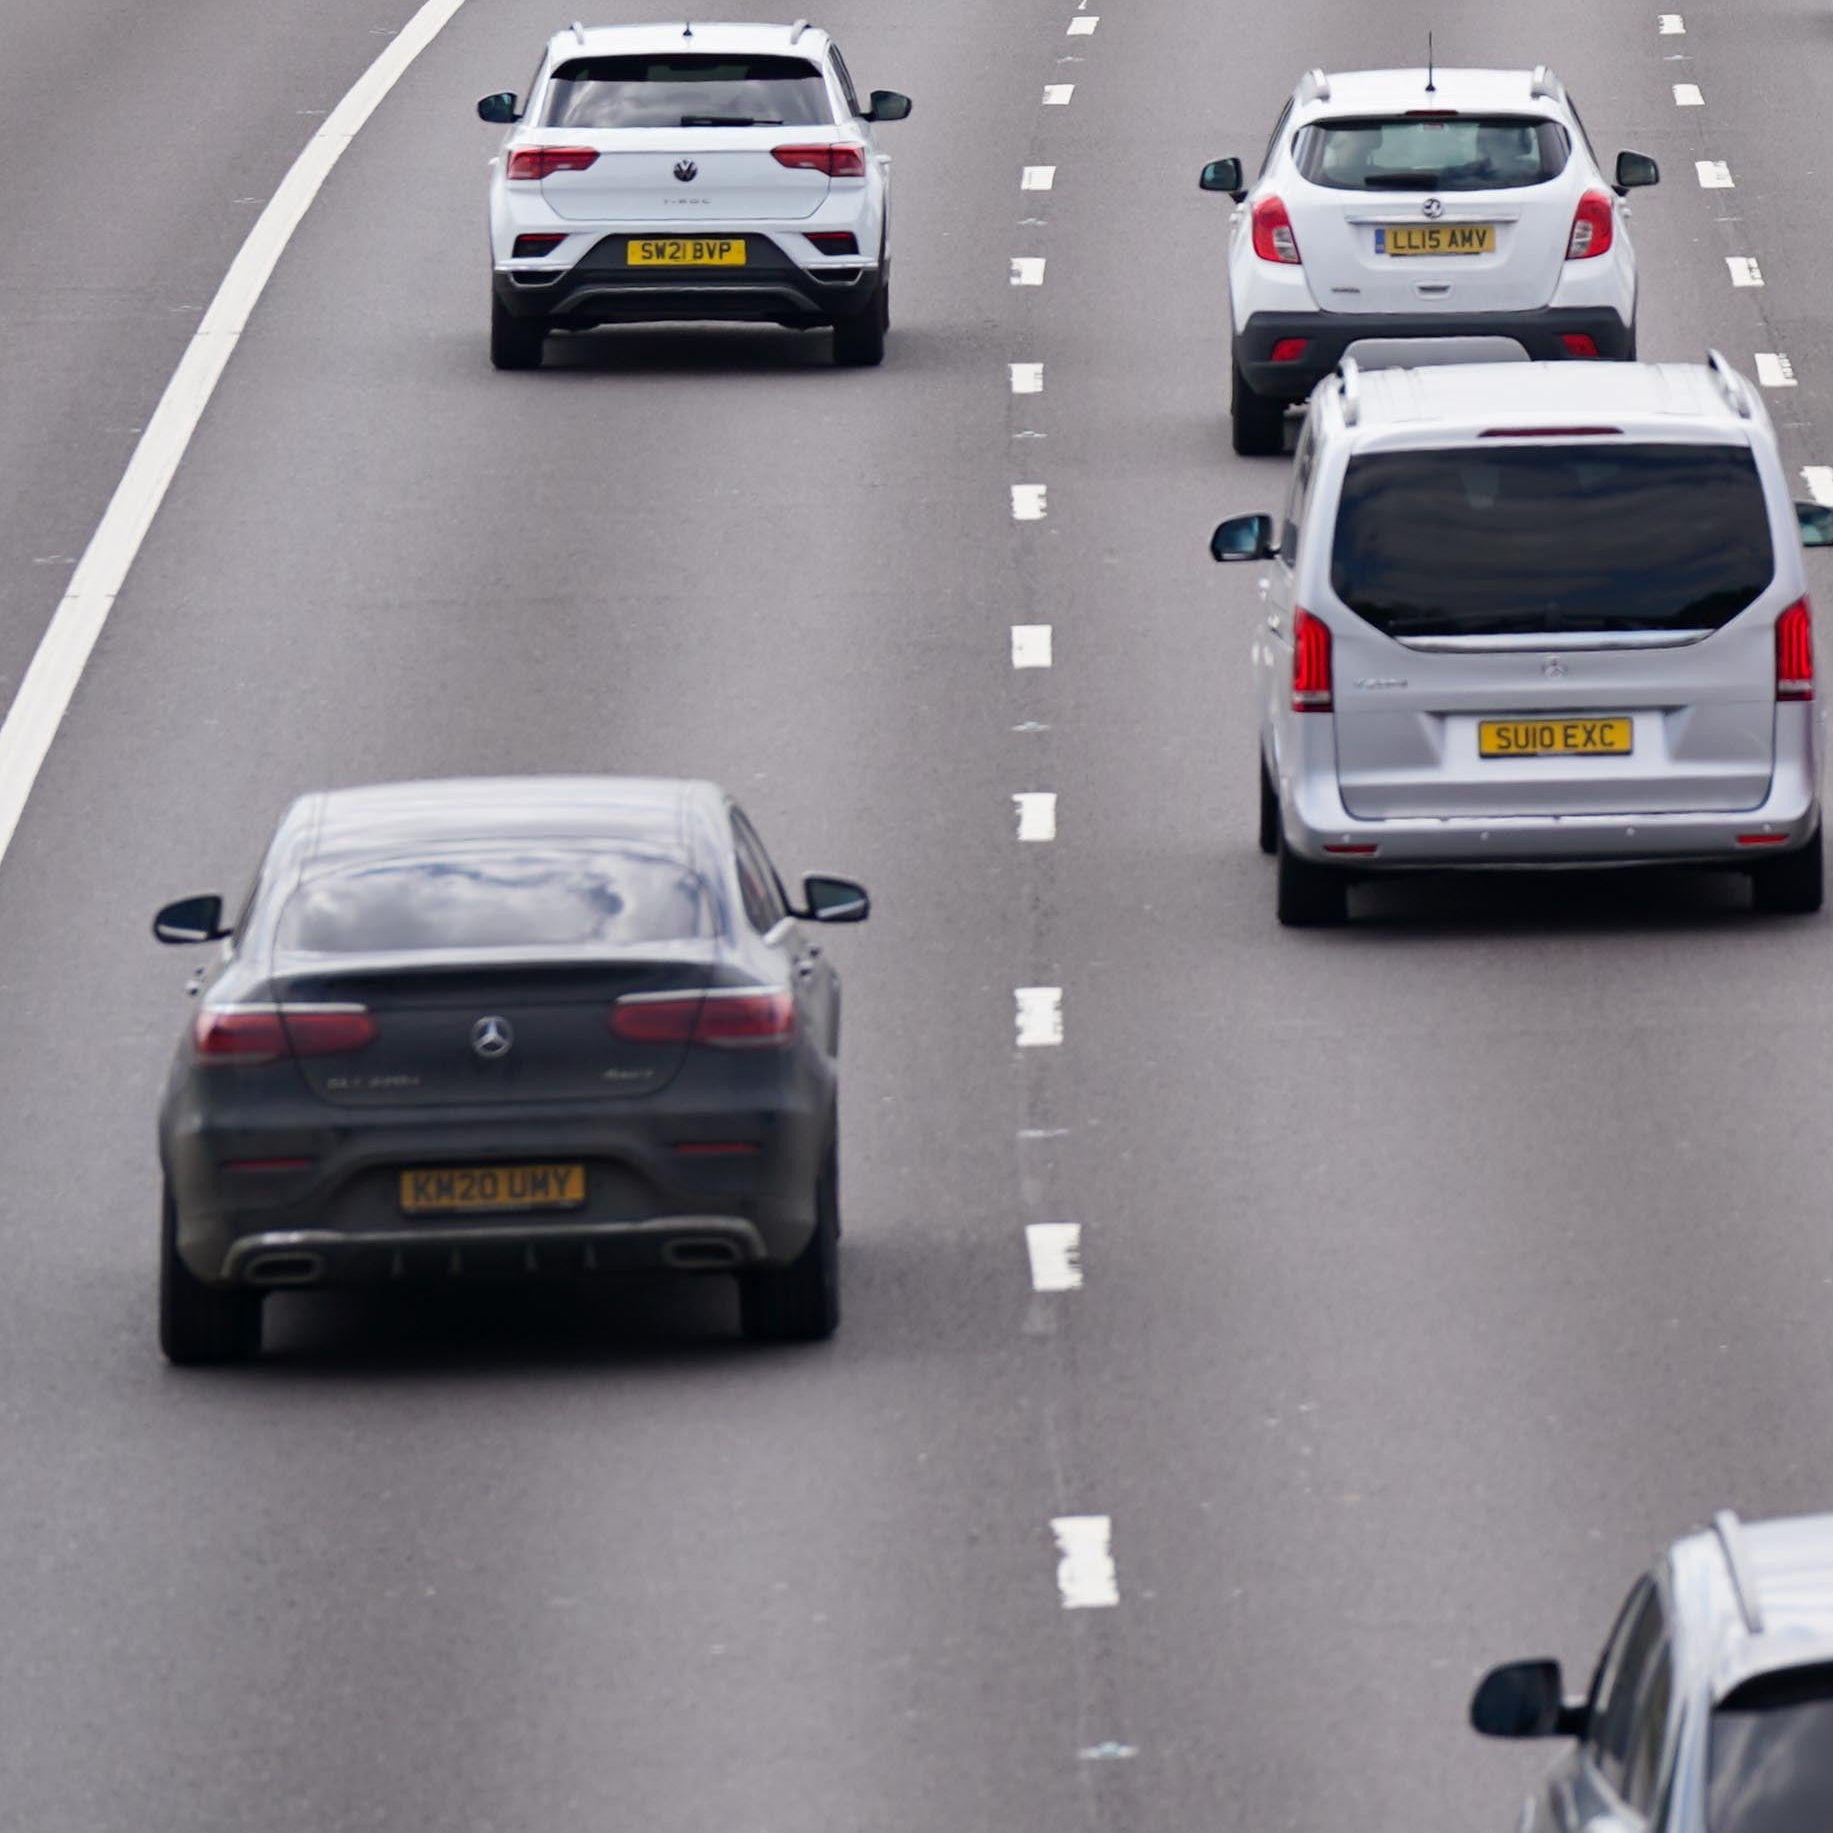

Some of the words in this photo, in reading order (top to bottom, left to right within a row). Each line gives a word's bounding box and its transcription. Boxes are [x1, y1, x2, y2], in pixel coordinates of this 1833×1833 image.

[642, 242, 687, 261] SW21
[693, 242, 732, 261] BVP
[1392, 231, 1443, 251] LL15
[1448, 229, 1488, 249] AMV
[1496, 726, 1555, 750] SU10
[1564, 724, 1616, 747] EXC
[412, 1169, 498, 1203] KM20
[508, 1167, 571, 1200] UMY
